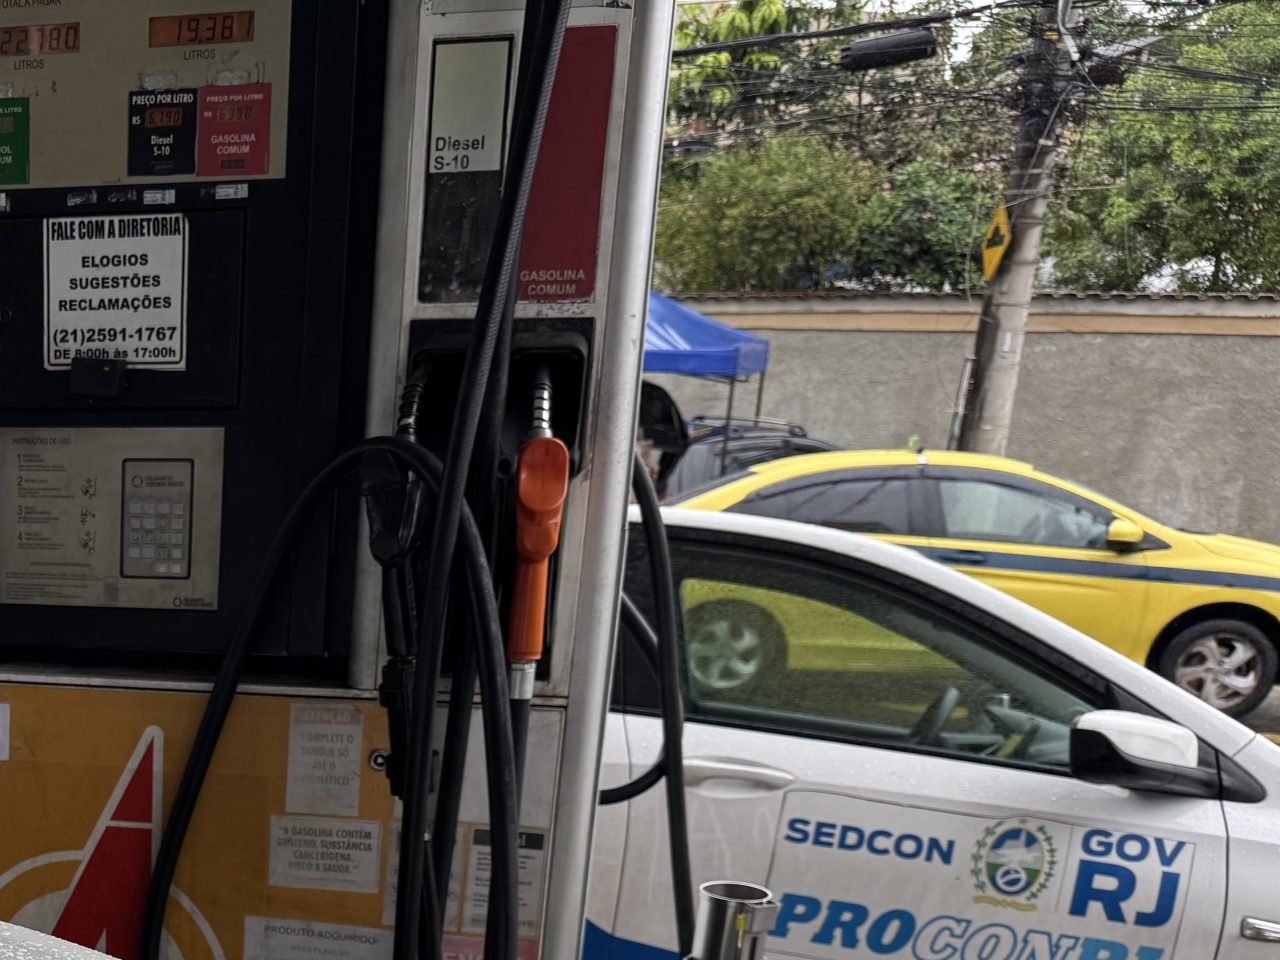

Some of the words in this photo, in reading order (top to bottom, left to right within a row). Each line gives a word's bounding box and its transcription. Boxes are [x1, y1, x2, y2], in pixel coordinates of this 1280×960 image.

[183, 49, 216, 61] LITROS
[13, 60, 45, 70] LITROS
[132, 95, 155, 106] PREÇO
[156, 94, 172, 104] POR
[173, 93, 194, 103] LITRO
[151, 134, 174, 145] Diesel
[210, 133, 256, 144] GASOLINA
[435, 135, 485, 152] Diesel
[153, 146, 170, 155] S-10
[216, 145, 251, 154] COMUM
[434, 154, 470, 171] S-10
[51, 221, 76, 241] FALE
[78, 219, 105, 240] COM
[107, 219, 116, 239] A
[119, 216, 181, 238] DIRETORIA
[81, 254, 149, 268] ELOGIOS
[69, 273, 161, 290] SUGESTÕES
[520, 269, 585, 282] GASOLINA
[528, 283, 576, 295] COMUM
[58, 294, 172, 312] RECLAMAÇÕES
[53, 327, 177, 347] (21)2591-1767
[54, 349, 72, 360] DE
[75, 348, 109, 359] 8:00h
[113, 348, 128, 358] às
[133, 347, 176, 358] 17:00h
[291, 826, 334, 839] GASOLINA
[335, 827, 372, 840] CONTÉM
[784, 818, 955, 865] SEDCON
[1081, 829, 1188, 868] GOV
[1069, 859, 1181, 928] RJ
[264, 923, 314, 937] PRODUTO
